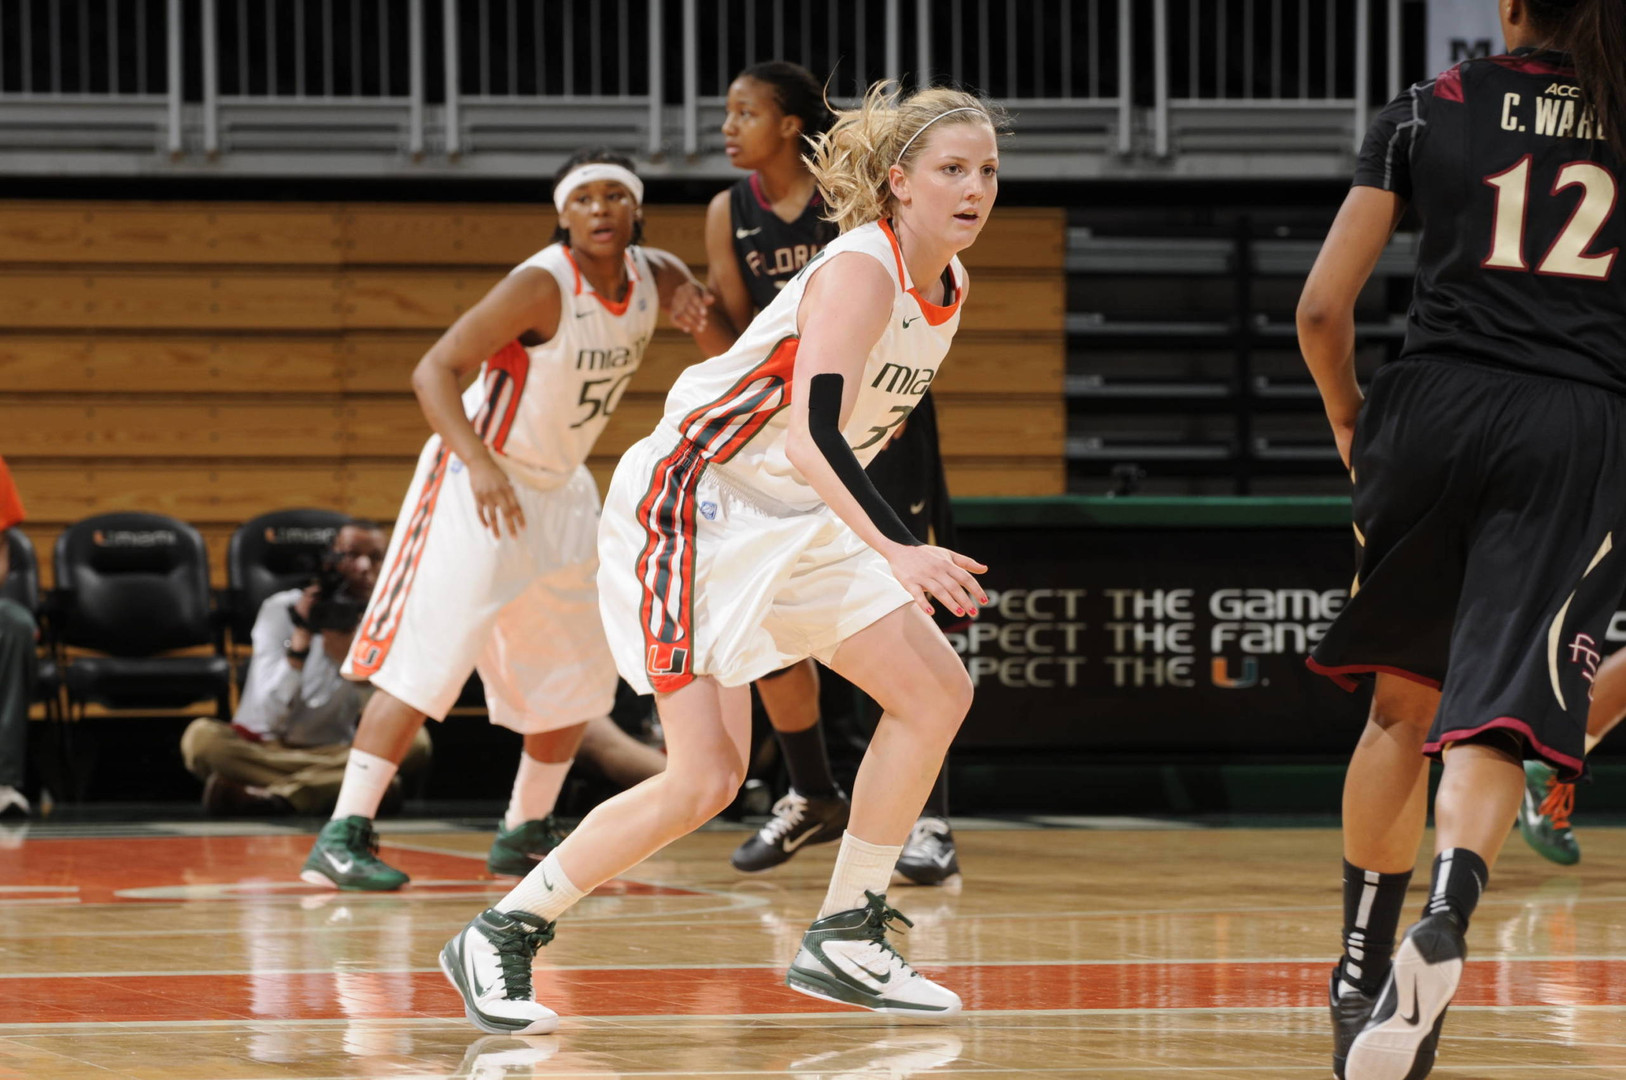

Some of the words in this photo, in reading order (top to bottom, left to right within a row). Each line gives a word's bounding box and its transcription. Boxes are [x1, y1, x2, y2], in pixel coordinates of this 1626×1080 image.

[1544, 83, 1580, 97] ACC
[1501, 92, 1526, 132] C.
[1535, 96, 1606, 140] WAR
[1480, 153, 1619, 281] 12
[745, 244, 828, 277] FLORI
[969, 589, 1087, 620] PECT
[1104, 589, 1195, 620] THE
[945, 622, 1087, 654] SPECT
[1104, 622, 1195, 654] THE
[647, 645, 688, 675] U
[968, 656, 1087, 688] PECT
[1104, 656, 1195, 688] THE
